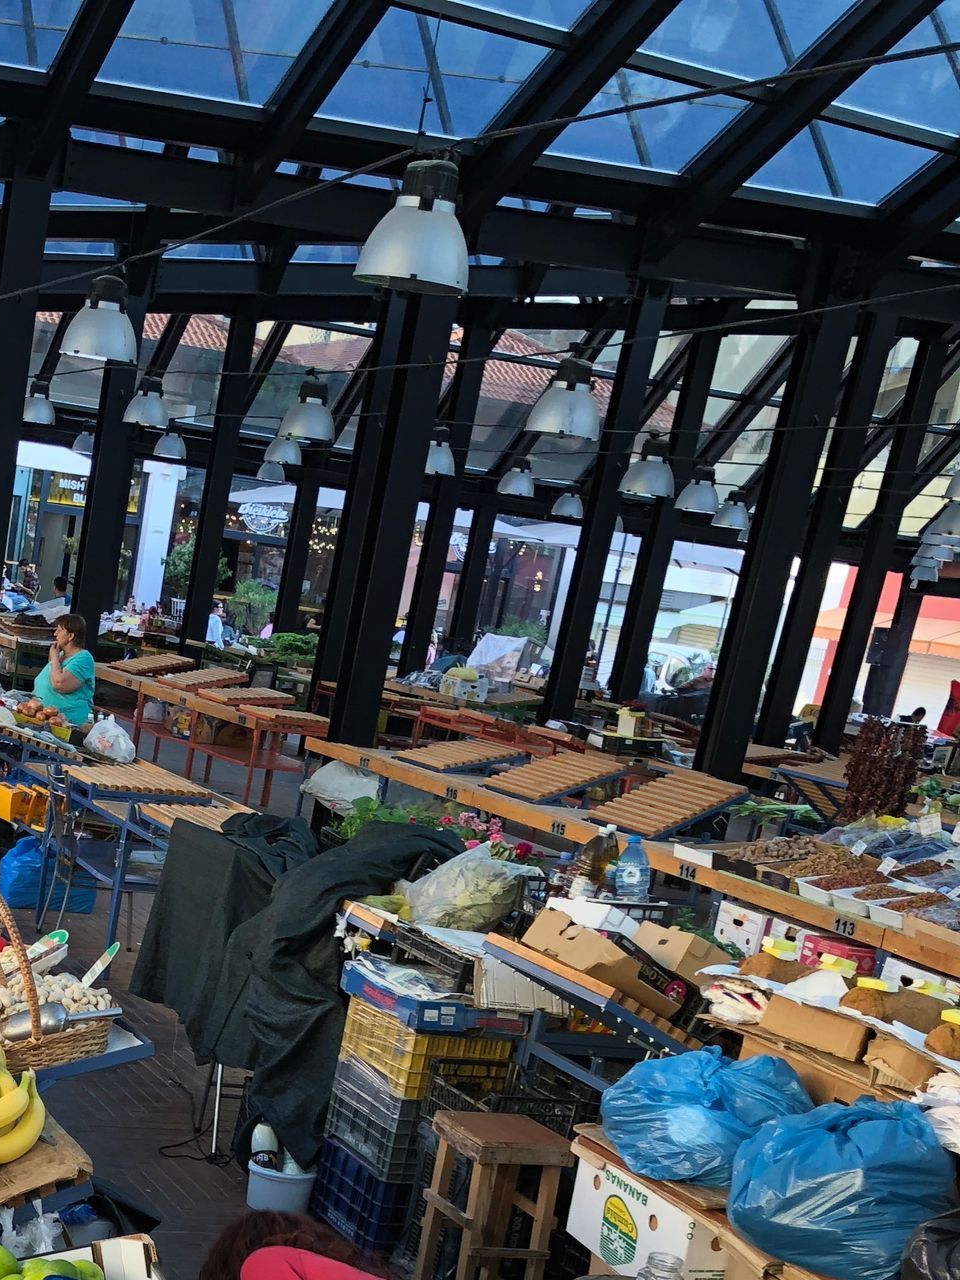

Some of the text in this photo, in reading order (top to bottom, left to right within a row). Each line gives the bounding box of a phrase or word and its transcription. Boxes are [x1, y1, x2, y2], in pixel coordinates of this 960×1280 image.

[58, 479, 85, 491] MISH
[551, 821, 566, 836] 115
[678, 864, 697, 880] 114
[834, 918, 856, 936] 113
[604, 1169, 649, 1206] BANANAS
